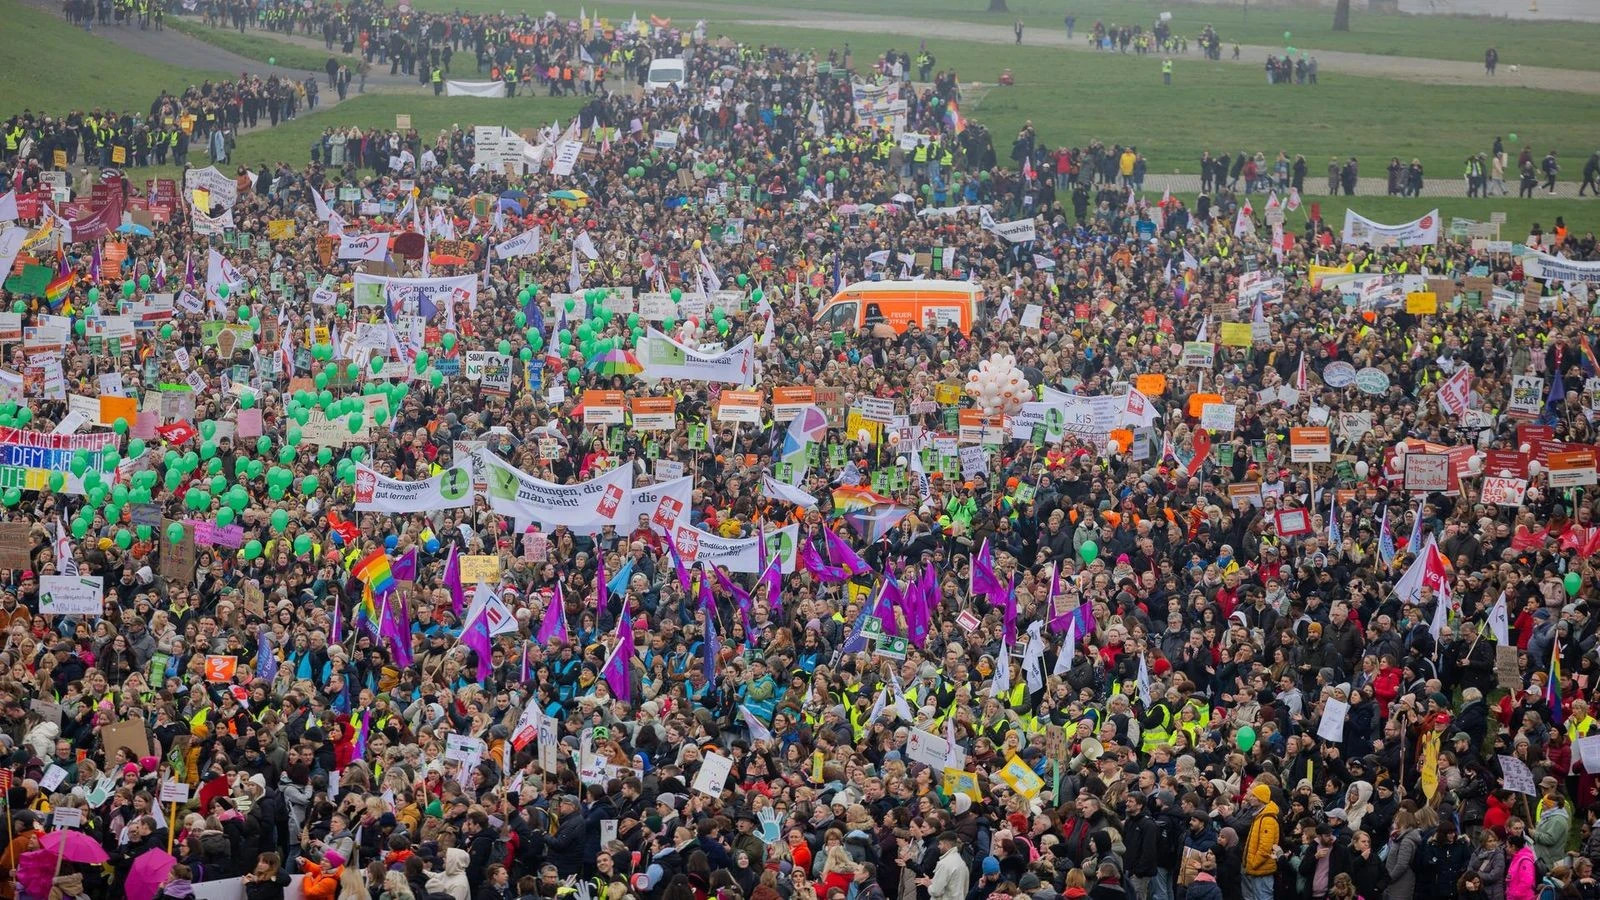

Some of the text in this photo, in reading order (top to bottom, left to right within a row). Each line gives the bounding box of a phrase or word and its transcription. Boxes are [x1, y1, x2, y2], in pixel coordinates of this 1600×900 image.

[1542, 266, 1577, 280] Zukunft
[439, 284, 453, 292] die
[468, 365, 482, 374] NR
[486, 374, 508, 382] STAAT
[1022, 410, 1044, 420] Ganztag
[12, 446, 44, 468] DEM
[404, 482, 430, 492] gleich
[584, 484, 604, 494] die
[1486, 479, 1518, 489] NRW
[375, 492, 388, 500] gut
[518, 490, 545, 503] man
[638, 492, 658, 503] die
[541, 728, 557, 746] RW
